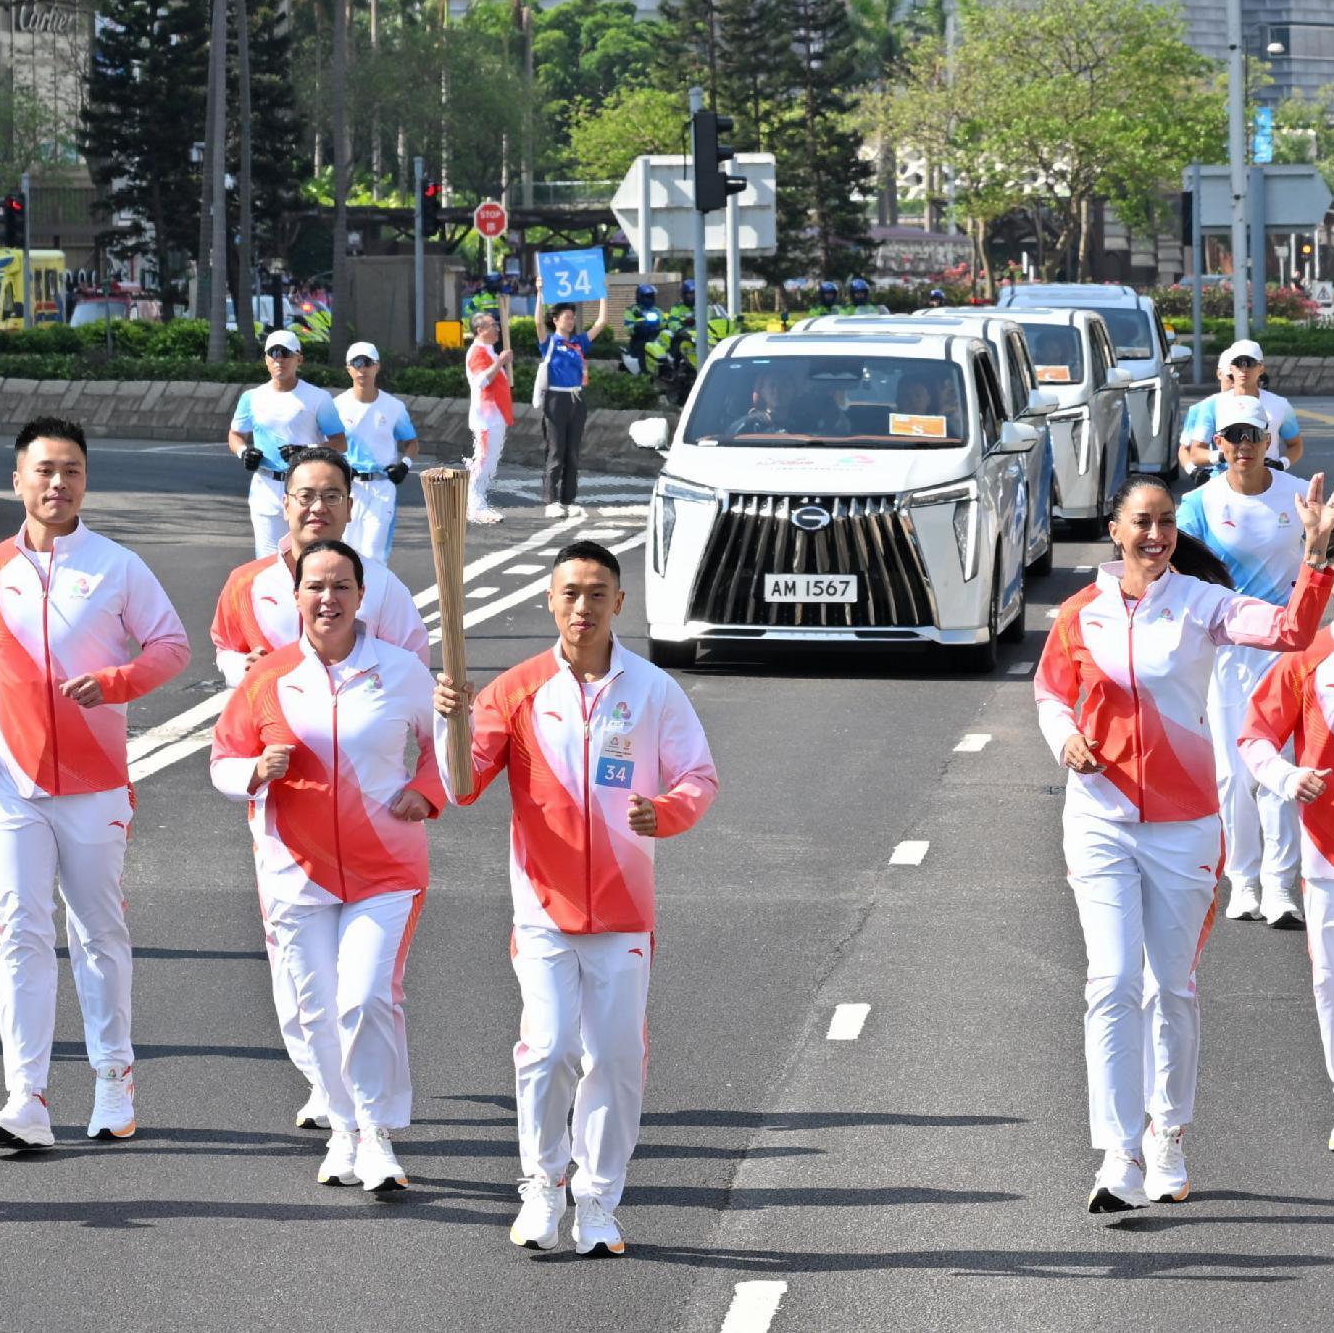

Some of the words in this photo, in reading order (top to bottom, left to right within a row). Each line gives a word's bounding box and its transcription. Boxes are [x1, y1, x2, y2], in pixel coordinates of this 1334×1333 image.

[19, 4, 75, 33] Cartier
[554, 269, 593, 298] 34
[770, 580, 797, 597] AM
[805, 580, 851, 597] 1567
[604, 764, 627, 782] 34
